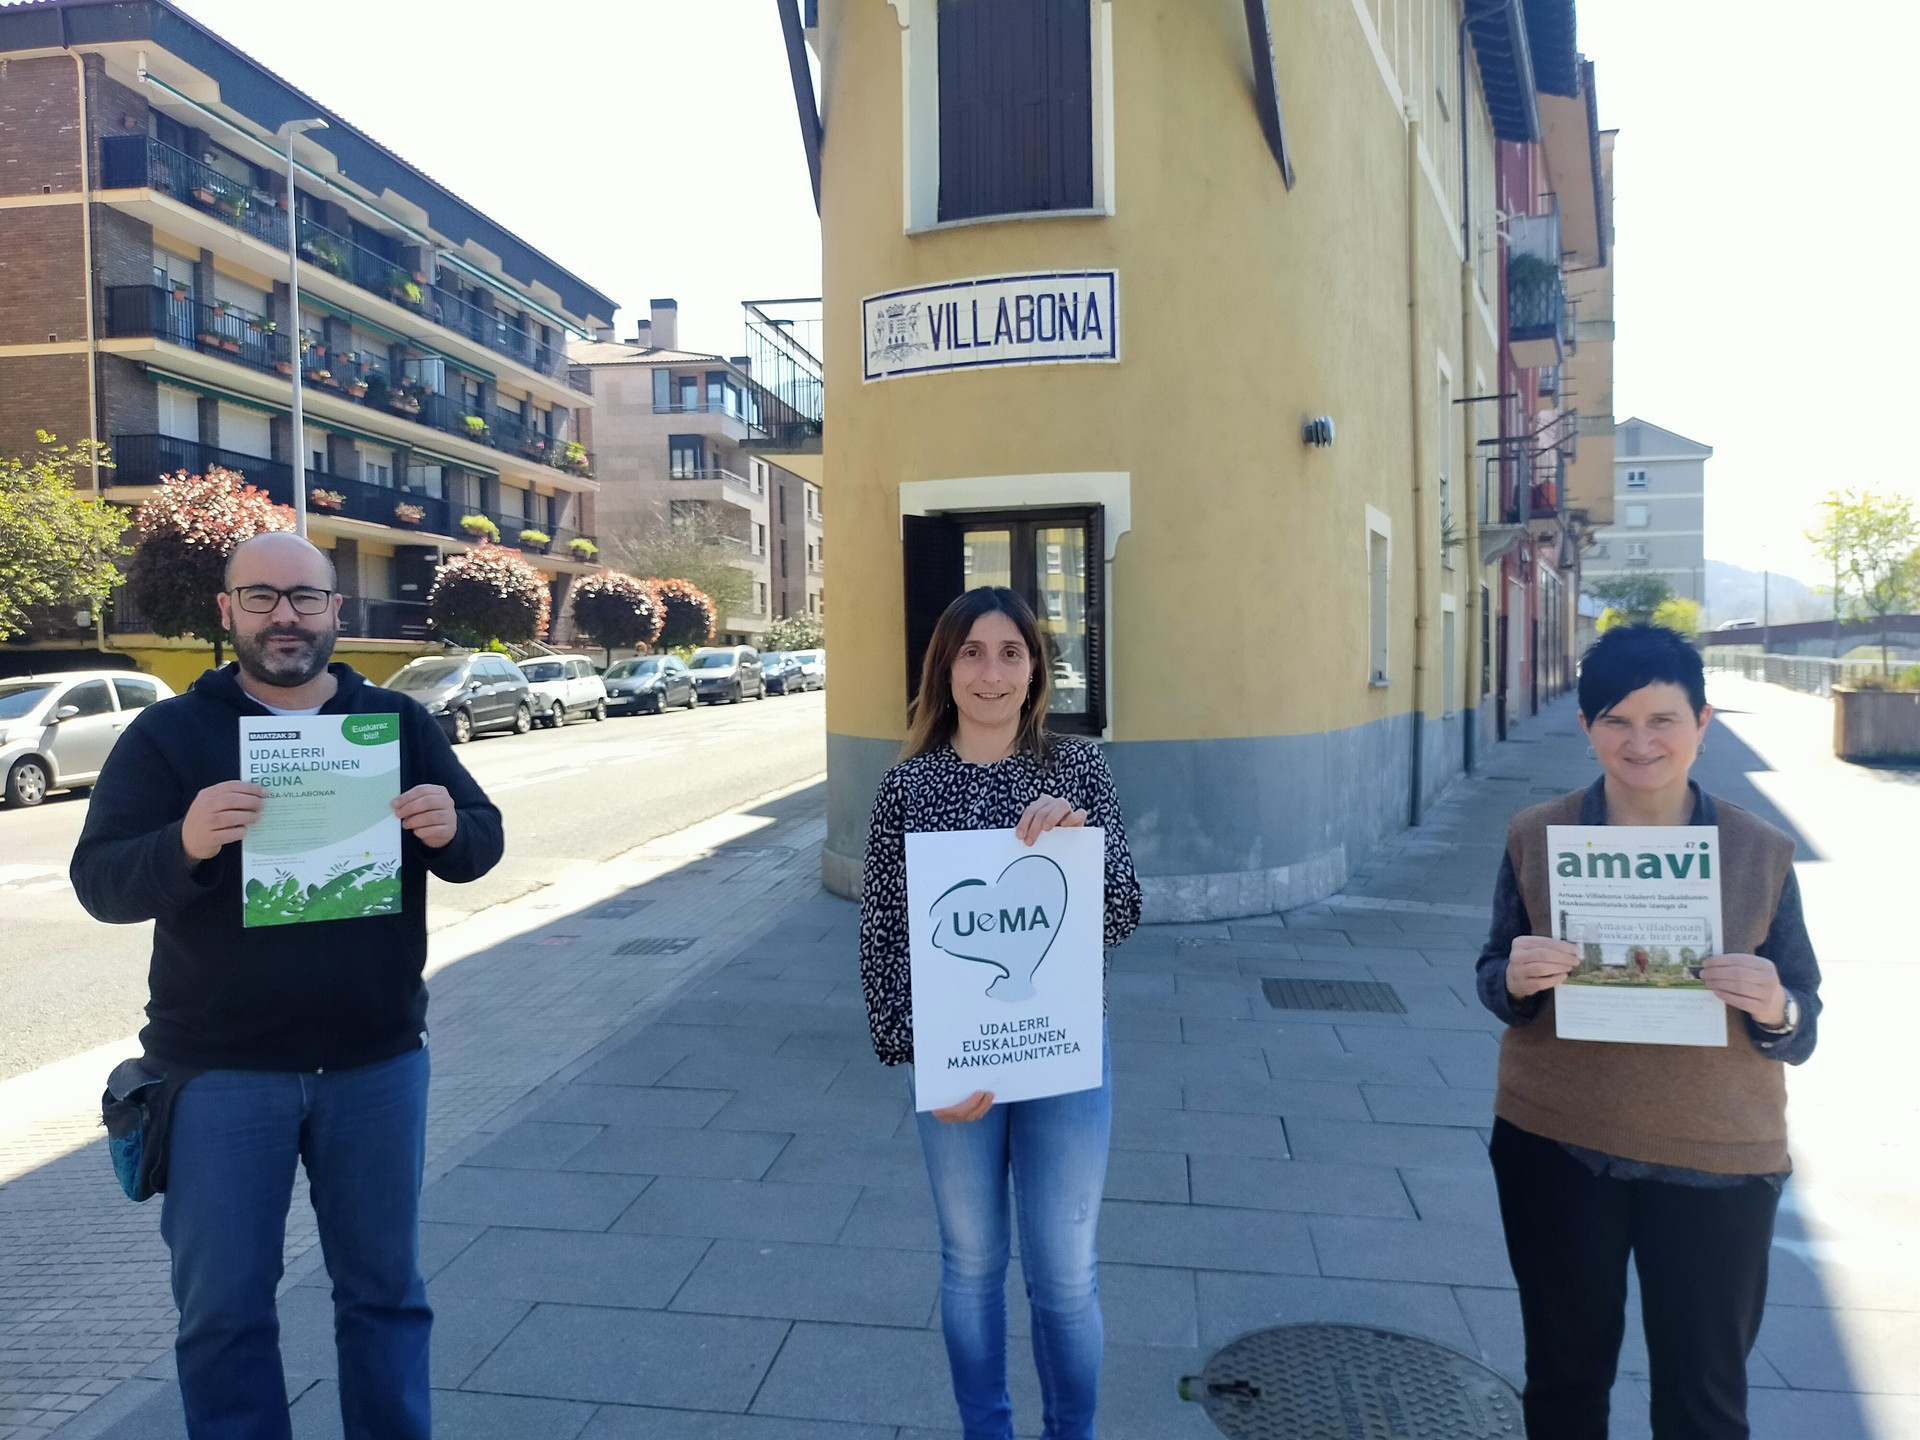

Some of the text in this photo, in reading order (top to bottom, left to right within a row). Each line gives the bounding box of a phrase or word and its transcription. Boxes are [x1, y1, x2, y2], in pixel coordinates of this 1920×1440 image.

[928, 291, 1103, 352] VILLABONA
[352, 722, 389, 734] Euskaraz
[250, 732, 287, 740] MAIATZAK
[250, 747, 325, 760] UDALERRI
[250, 760, 360, 774] EUSKALDUNEN
[250, 776, 304, 788] EGUNA
[1683, 841, 1696, 849] 47
[1557, 841, 1711, 879] amavi
[1677, 902, 1688, 910] da
[953, 905, 1051, 937] UeMA
[1674, 933, 1699, 942] gara
[980, 1016, 1050, 1036] UDALERRI
[963, 1029, 1067, 1053] EUSKALDUNEN
[947, 1042, 1081, 1069] MANKOMUNITATEA
